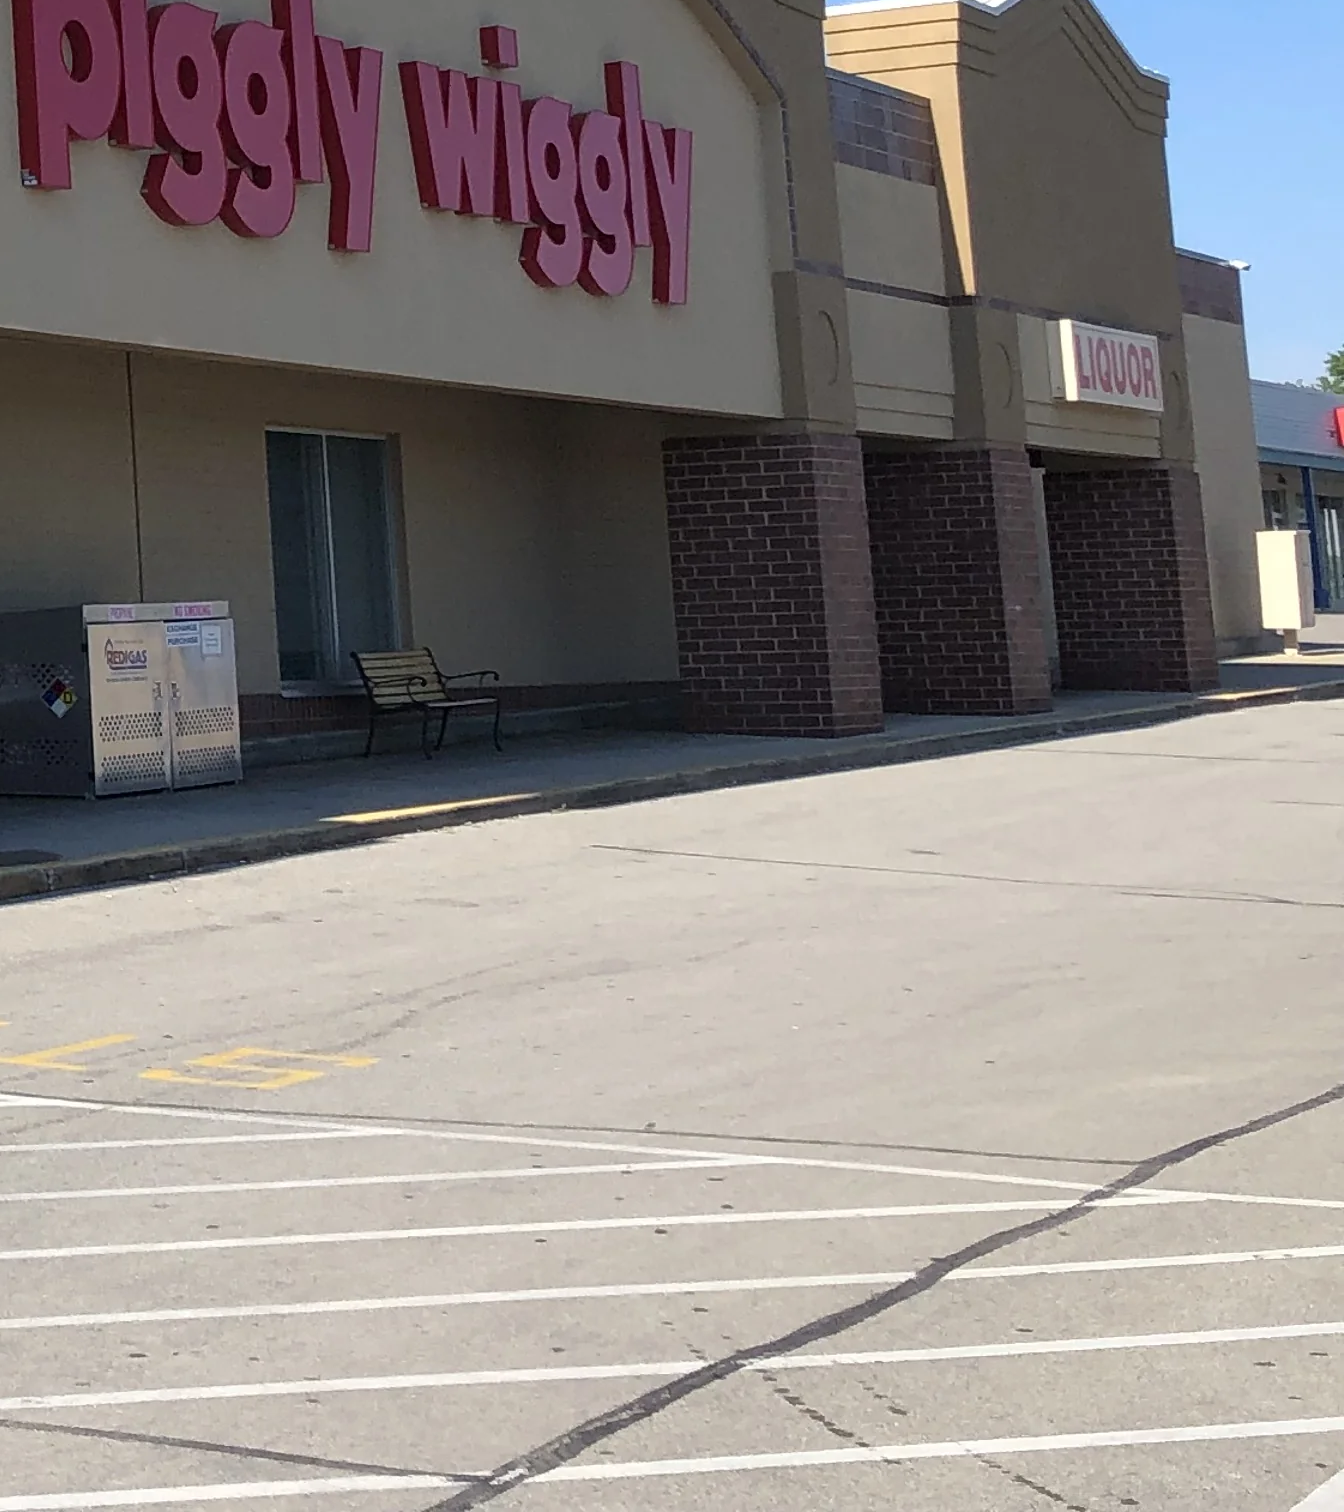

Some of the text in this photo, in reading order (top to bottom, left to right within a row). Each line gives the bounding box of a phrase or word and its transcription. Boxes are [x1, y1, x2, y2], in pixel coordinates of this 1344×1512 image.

[399, 24, 693, 306] wiggly
[1075, 335, 1157, 400] LIQUOR
[166, 624, 198, 633] EXCHANGE
[167, 636, 198, 646] PURCHASE
